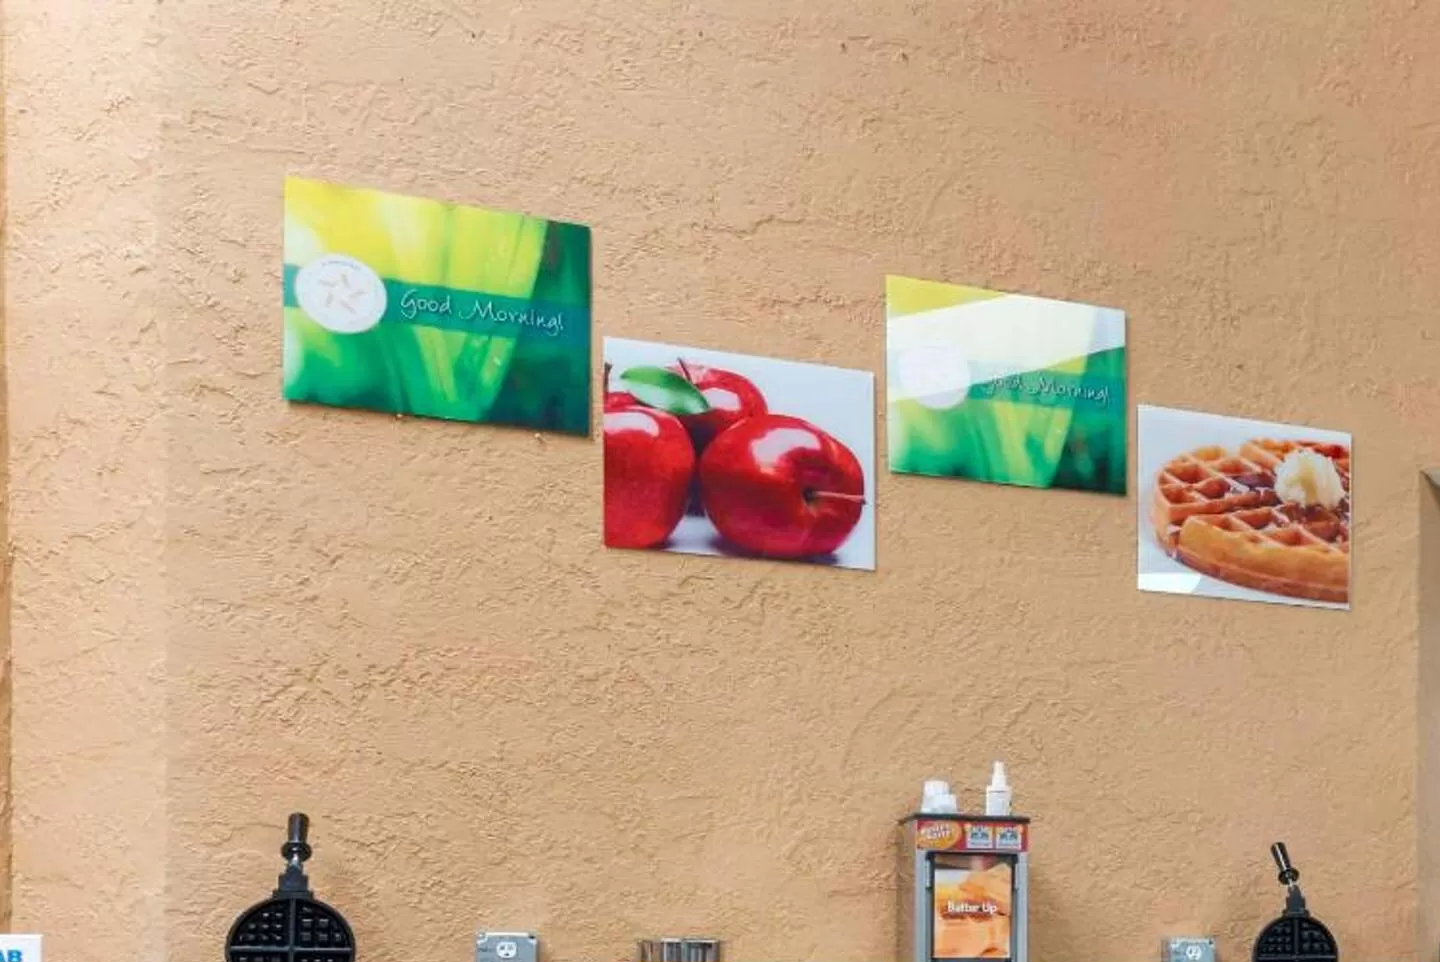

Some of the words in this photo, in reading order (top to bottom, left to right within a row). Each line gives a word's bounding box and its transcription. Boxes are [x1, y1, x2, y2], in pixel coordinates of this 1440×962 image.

[400, 288, 452, 319] Good
[458, 300, 564, 336] Morning!
[947, 900, 980, 913] Batter
[982, 901, 998, 915] Up
